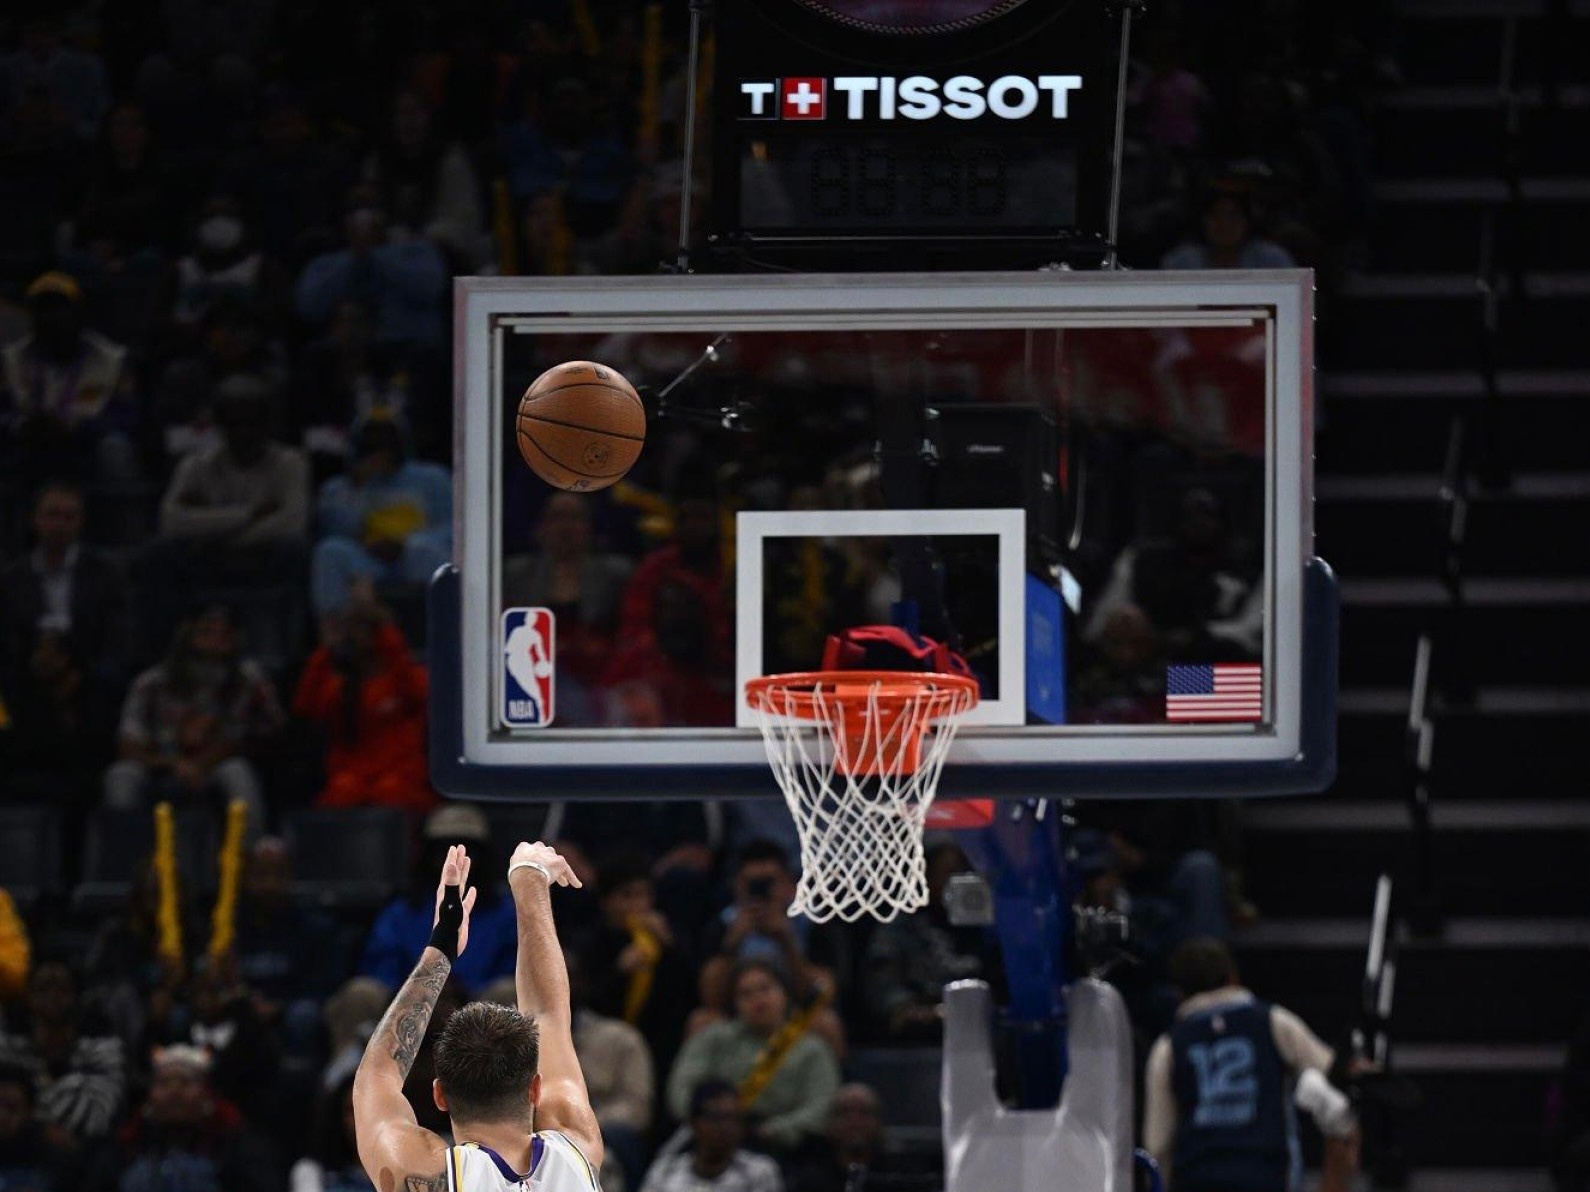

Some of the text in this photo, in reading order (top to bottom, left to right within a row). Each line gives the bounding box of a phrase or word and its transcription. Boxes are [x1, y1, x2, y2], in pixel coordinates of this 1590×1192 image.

[741, 75, 1083, 120] T TISSOT
[508, 699, 535, 719] NBA
[1187, 1036, 1257, 1101] 12
